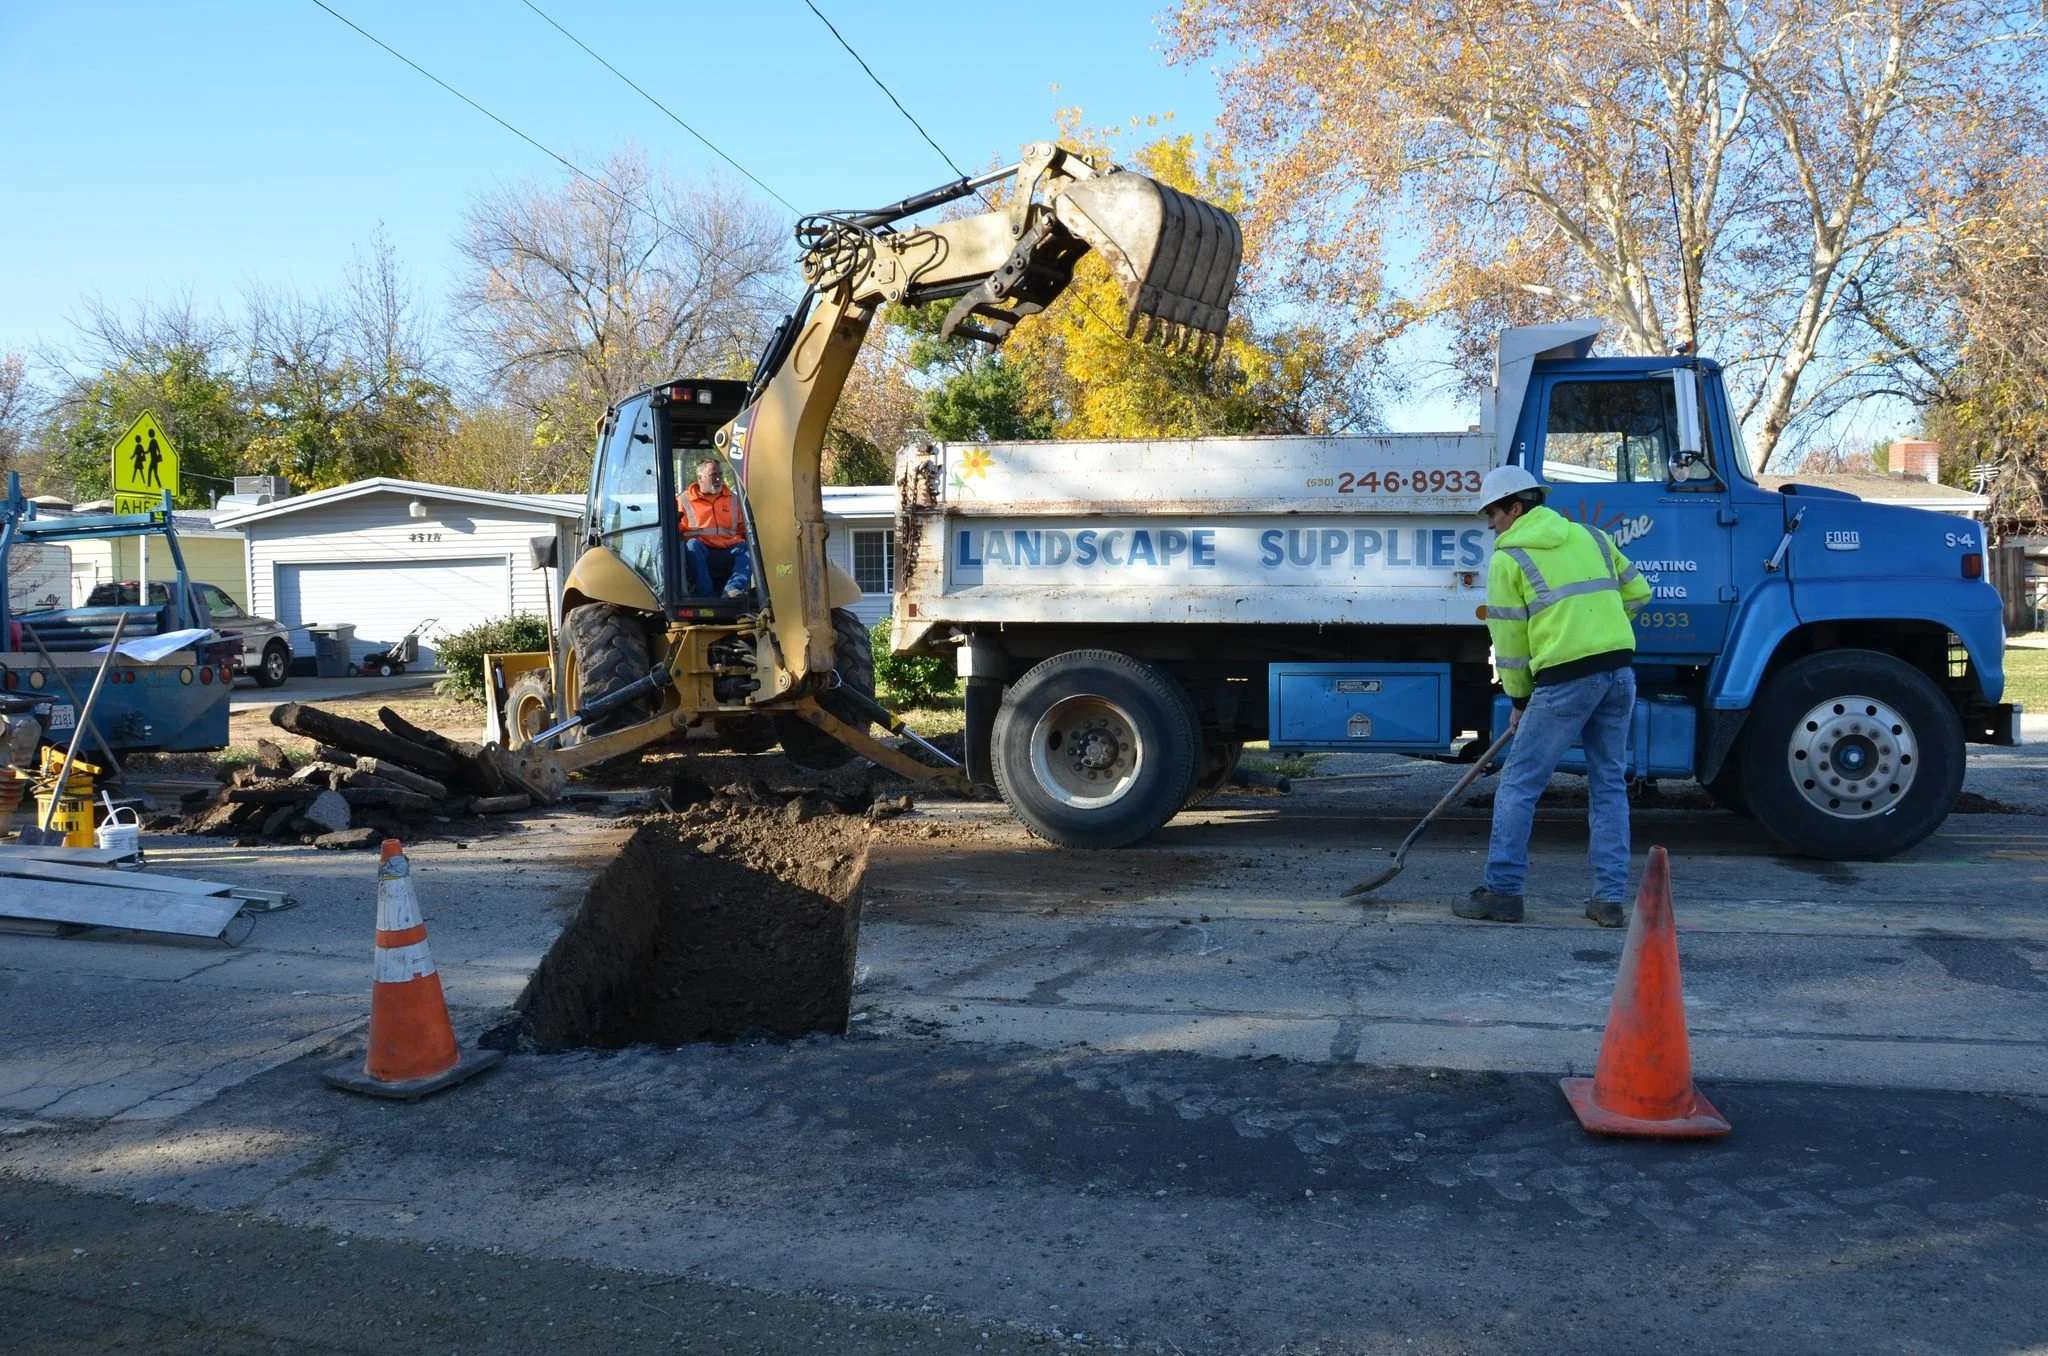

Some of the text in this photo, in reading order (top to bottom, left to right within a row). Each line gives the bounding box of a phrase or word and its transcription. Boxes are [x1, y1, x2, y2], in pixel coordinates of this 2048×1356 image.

[730, 422, 748, 460] CAT
[1306, 477, 1334, 488] (530)
[120, 499, 164, 515] AHE
[1825, 531, 1860, 543] FORD
[957, 529, 1485, 568] LANDSCAPE SUPPLIES
[1632, 560, 1698, 572] AVATING
[1644, 573, 1660, 583] nd
[1640, 612, 1690, 628] 8933
[51, 713, 73, 726] 2181
